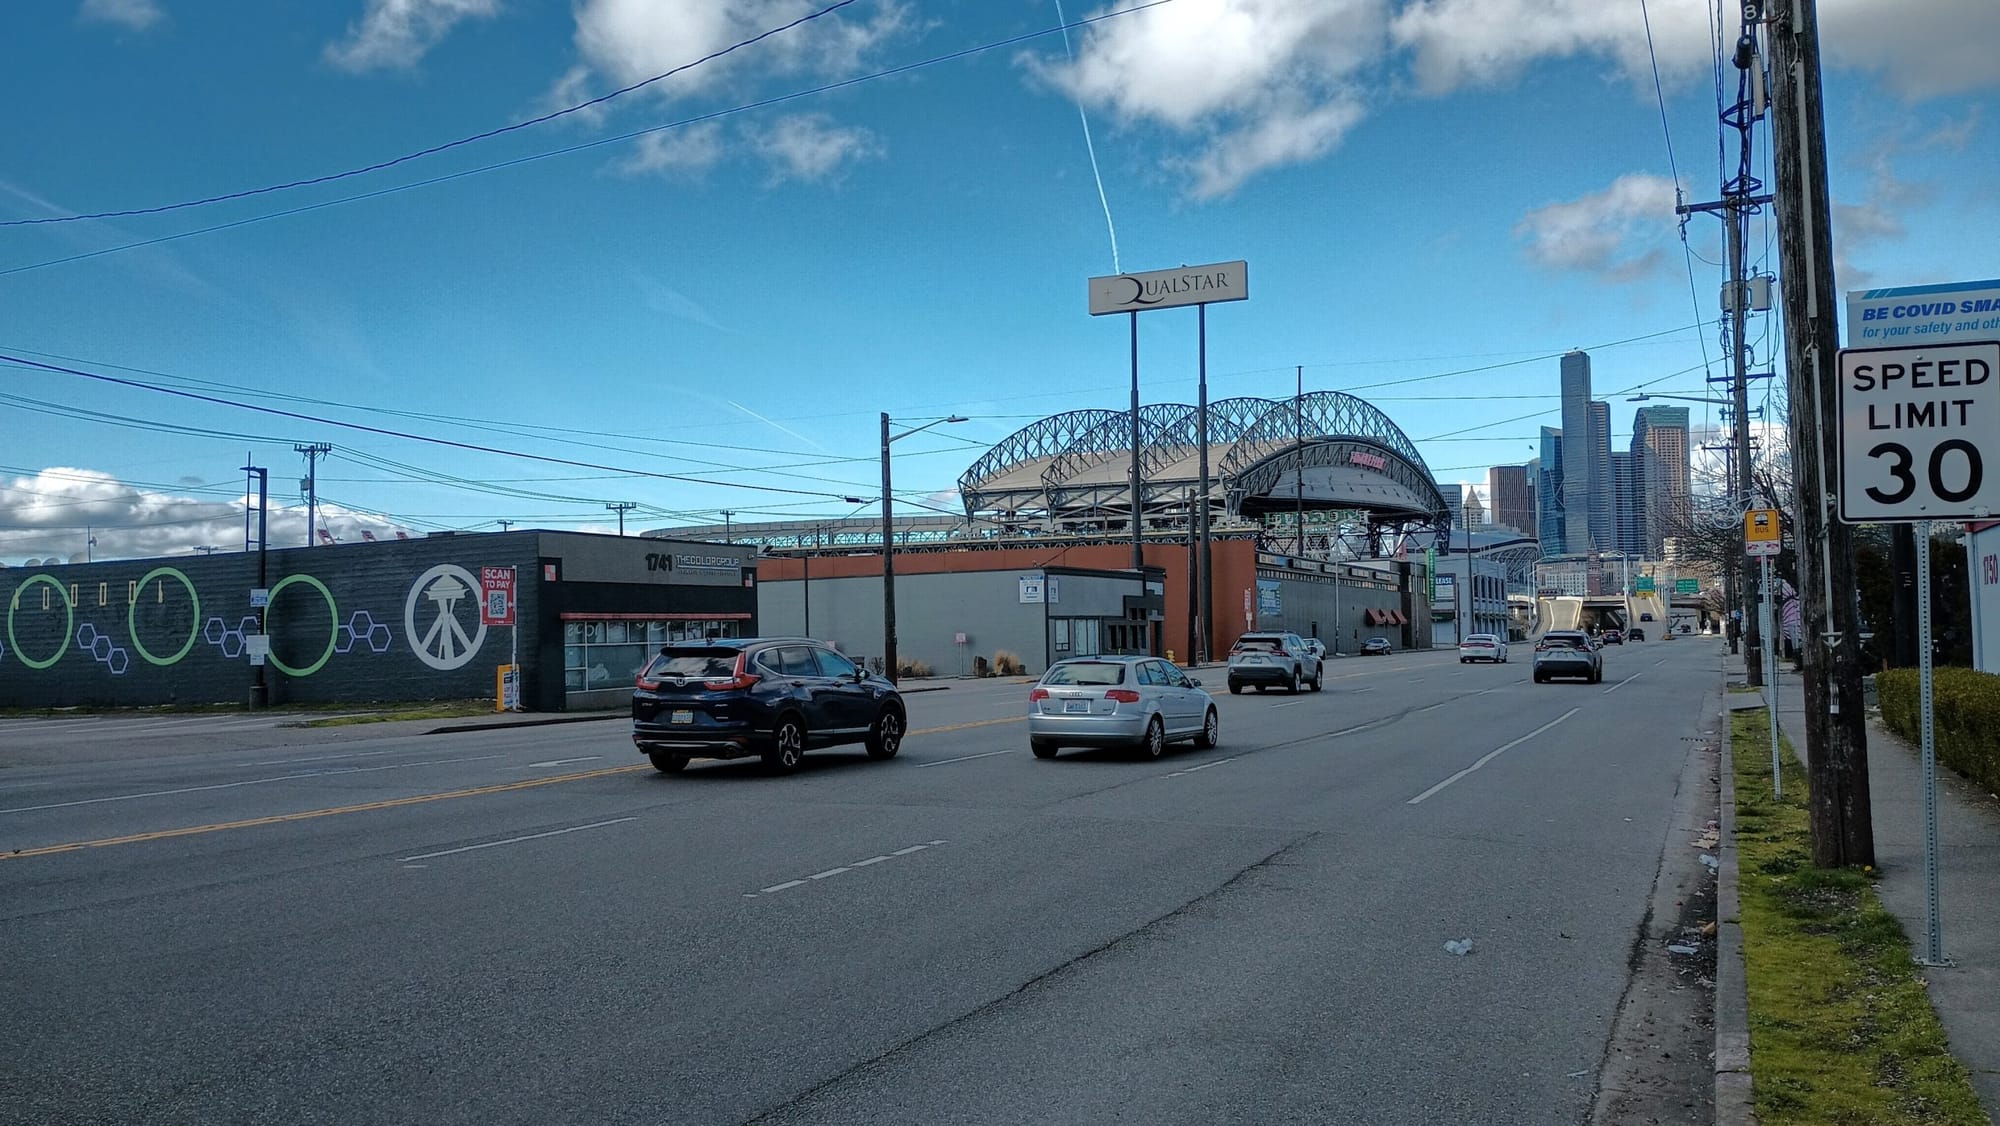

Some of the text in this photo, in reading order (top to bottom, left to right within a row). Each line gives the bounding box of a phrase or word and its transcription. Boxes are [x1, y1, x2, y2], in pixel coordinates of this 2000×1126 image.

[1114, 272, 1229, 305] QUALSTAR
[1863, 307, 1889, 321] BE
[1892, 302, 1956, 319] COVID
[1863, 327, 1881, 338] for
[1883, 326, 1911, 339] your
[1914, 322, 1952, 335] safety
[1955, 319, 1980, 331] and
[1853, 359, 1990, 391] SPEED
[1869, 399, 1974, 430] LIMIT
[1865, 439, 1983, 504] 30
[645, 553, 672, 571] 1741
[485, 569, 510, 579] SCAN
[485, 580, 510, 589] TO PAY
